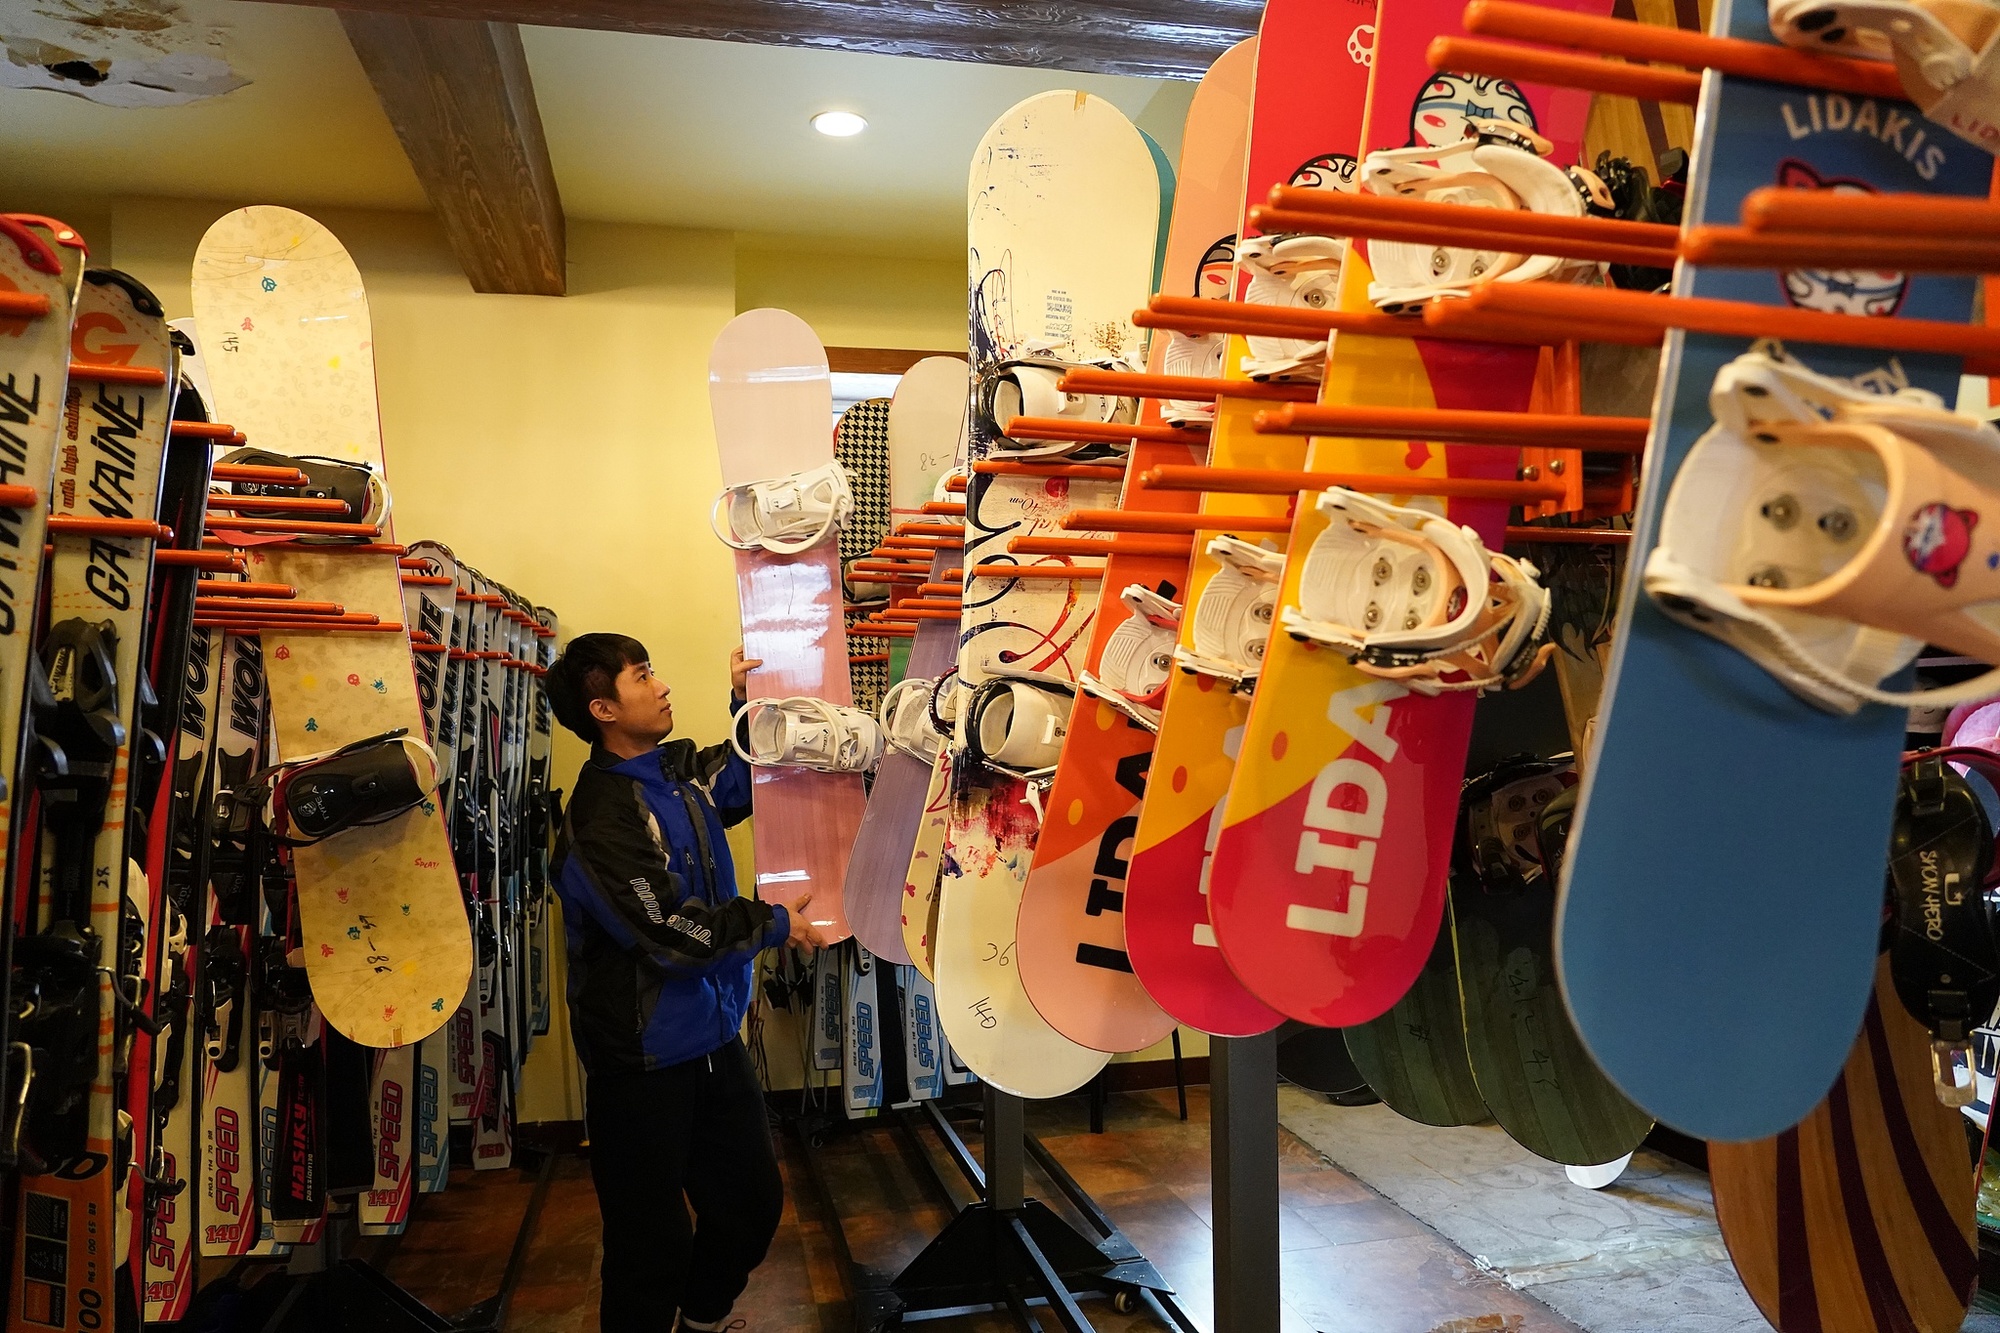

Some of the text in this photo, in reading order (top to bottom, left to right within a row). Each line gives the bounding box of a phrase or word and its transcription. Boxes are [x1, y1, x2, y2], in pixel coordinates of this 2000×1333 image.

[1780, 95, 1946, 182] LIDAKIS
[63, 444, 77, 474] high
[63, 478, 75, 509] with
[1286, 680, 1411, 938] LIDA
[1919, 850, 1943, 941] SNOW HERO
[983, 941, 1016, 967] 36
[457, 1006, 474, 1086] SPEED
[857, 1001, 874, 1079] SPEED
[915, 994, 934, 1069] SPEED
[378, 1079, 403, 1183] SPEED
[419, 1063, 438, 1158] SPEED
[215, 1105, 240, 1216] SPEED
[368, 1188, 399, 1207] 140
[205, 1224, 241, 1244] 140
